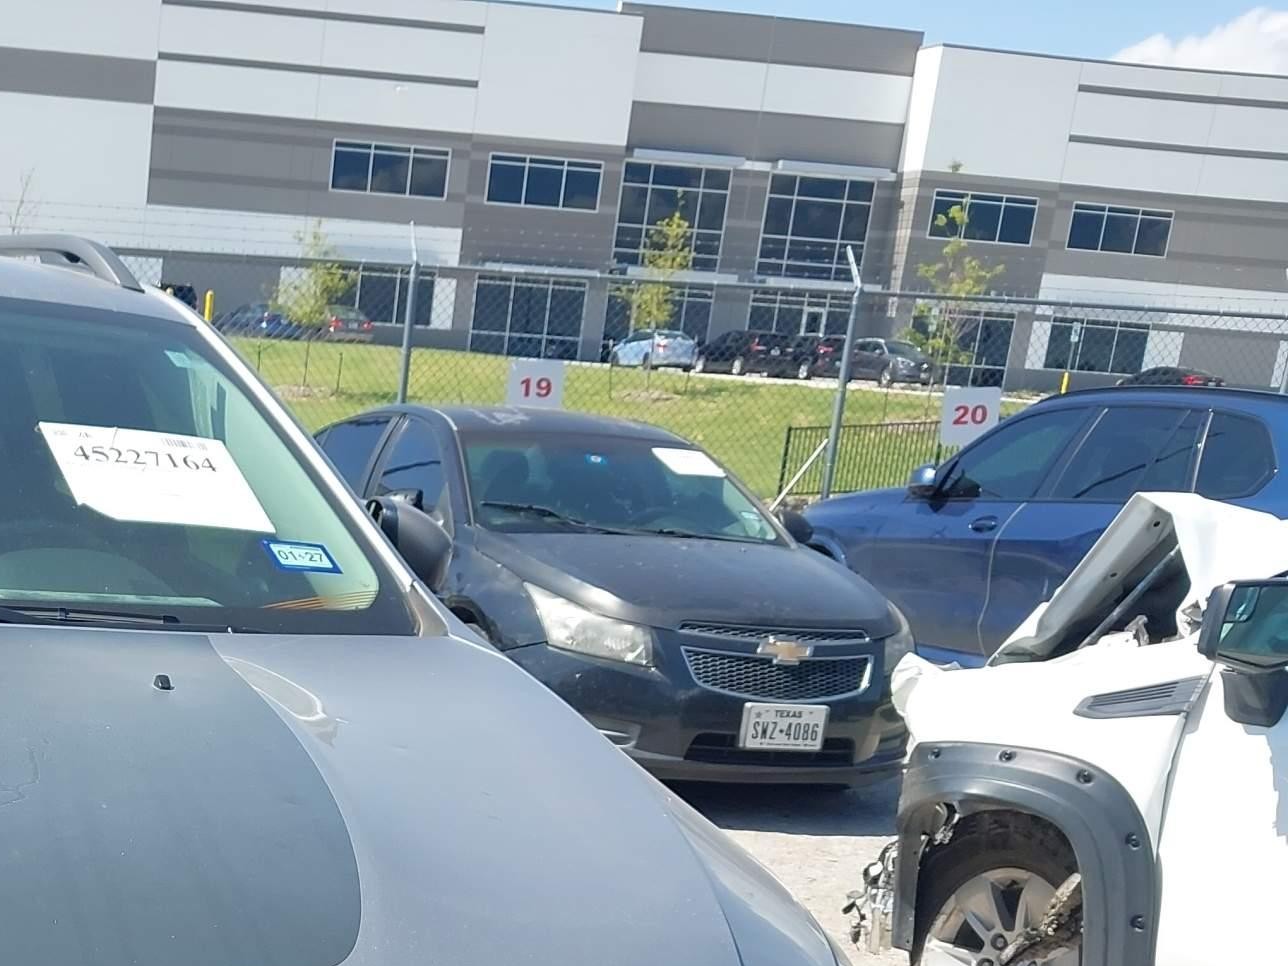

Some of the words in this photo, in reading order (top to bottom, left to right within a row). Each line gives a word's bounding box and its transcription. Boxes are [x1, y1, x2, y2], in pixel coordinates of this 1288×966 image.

[520, 377, 552, 398] 19
[952, 404, 988, 425] 20
[74, 445, 217, 472] 45227164
[775, 709, 804, 719] TEXAS
